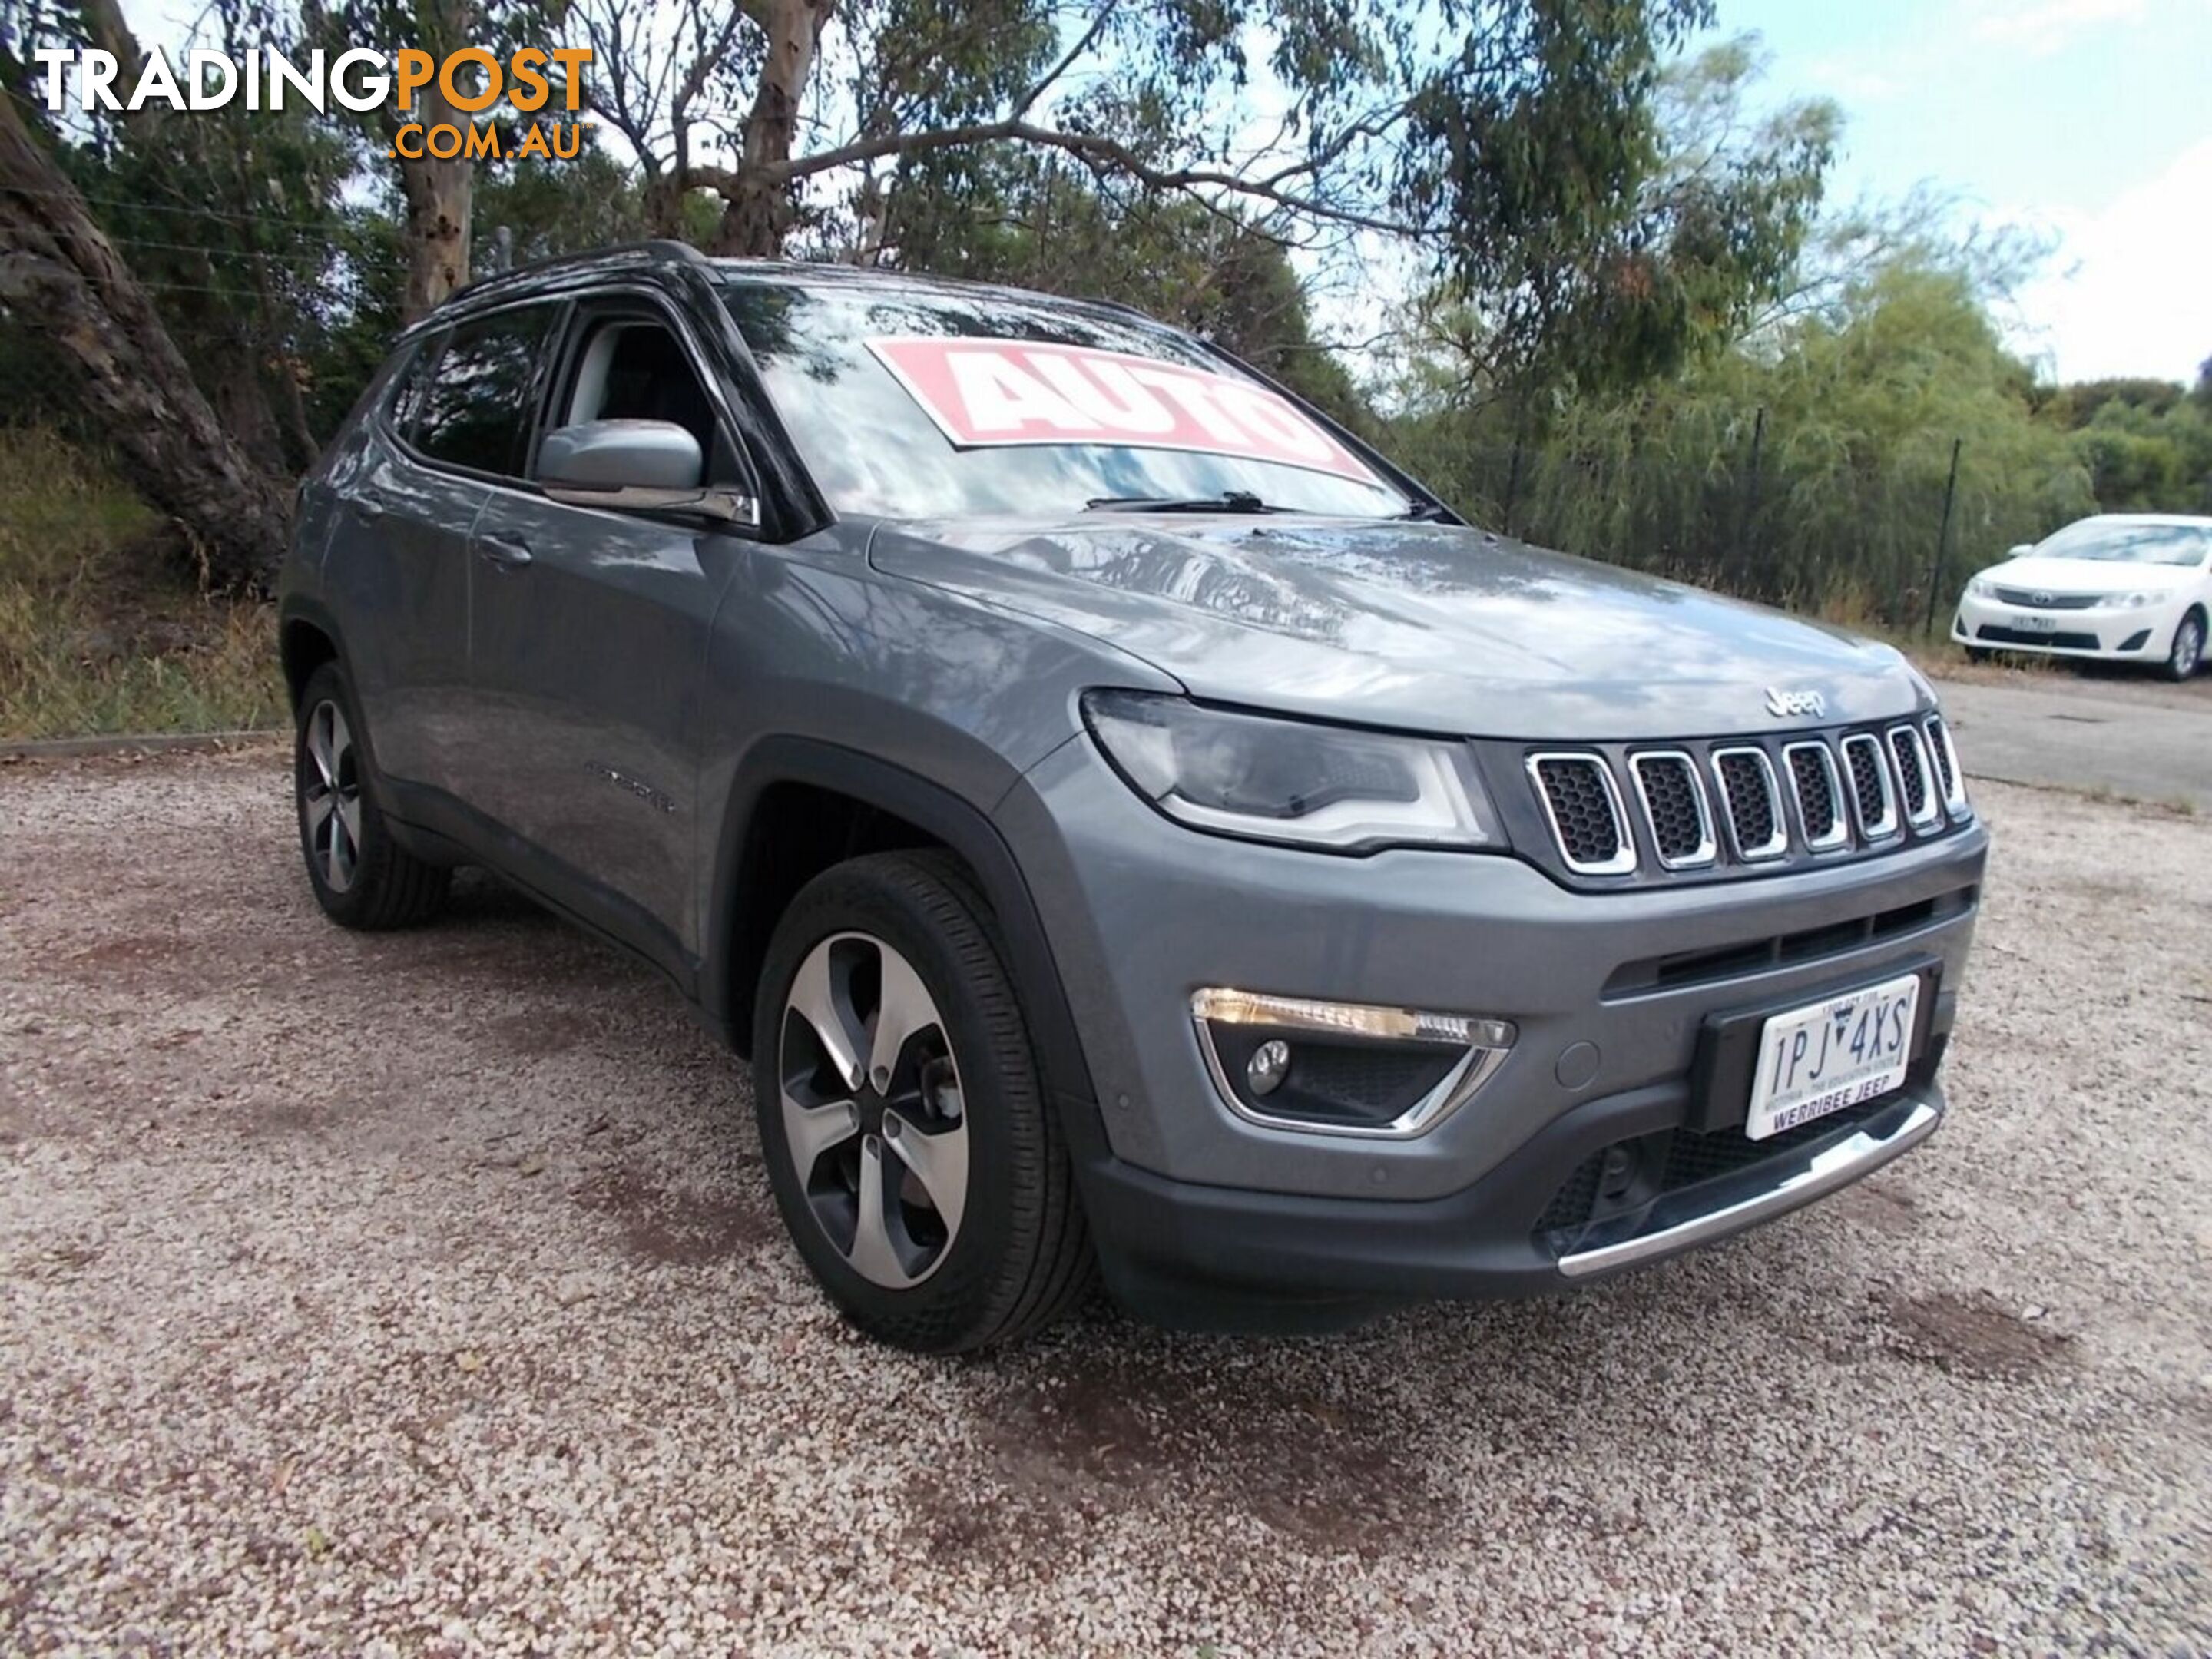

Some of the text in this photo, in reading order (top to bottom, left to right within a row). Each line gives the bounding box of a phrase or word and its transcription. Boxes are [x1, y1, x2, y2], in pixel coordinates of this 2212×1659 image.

[945, 351, 1336, 461] AUTO
[1766, 686, 1825, 719] Jeep
[1773, 1088, 1852, 1130] WERRIBEE
[1855, 1075, 1889, 1101] JEEP
